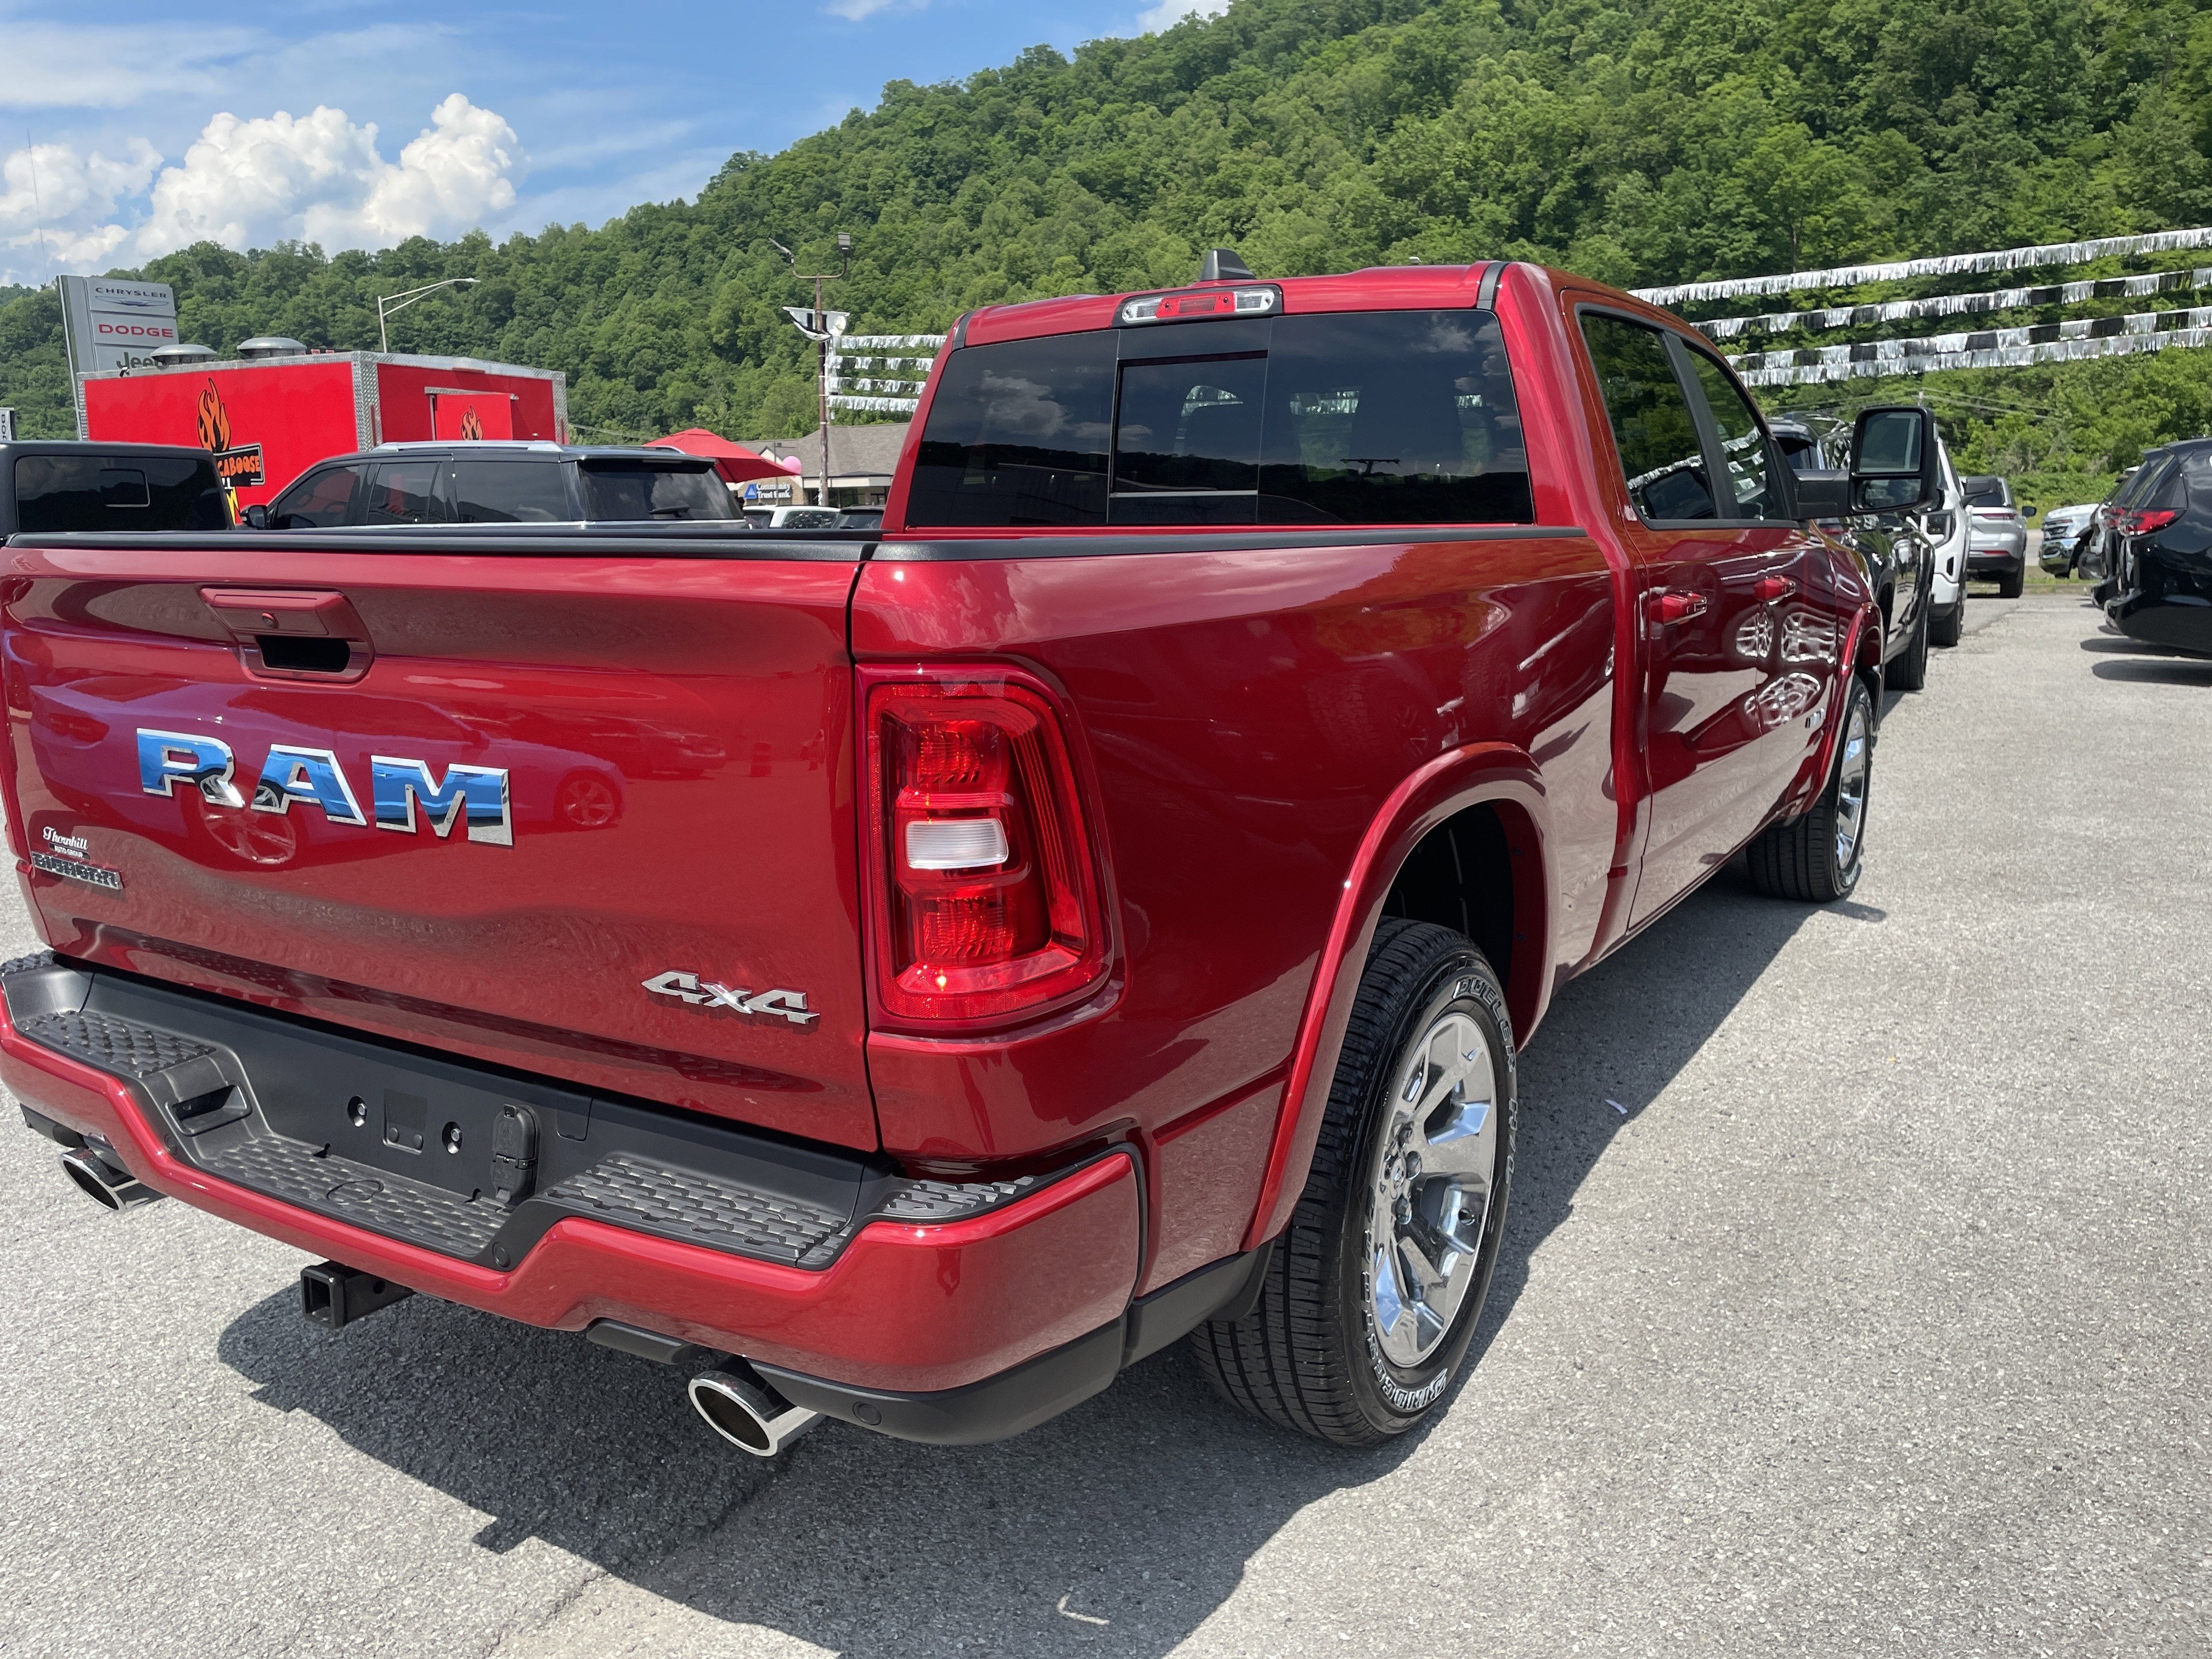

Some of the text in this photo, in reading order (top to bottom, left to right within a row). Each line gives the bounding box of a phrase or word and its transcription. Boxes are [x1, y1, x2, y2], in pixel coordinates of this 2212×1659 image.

[95, 287, 167, 298] CHRYSLER
[99, 324, 173, 338] DODGE
[217, 455, 261, 477] CABOOSE
[137, 727, 513, 845] RAM
[43, 826, 88, 850] Thornhill
[54, 845, 67, 855] AUTO
[1452, 976, 1516, 1073] DUELER
